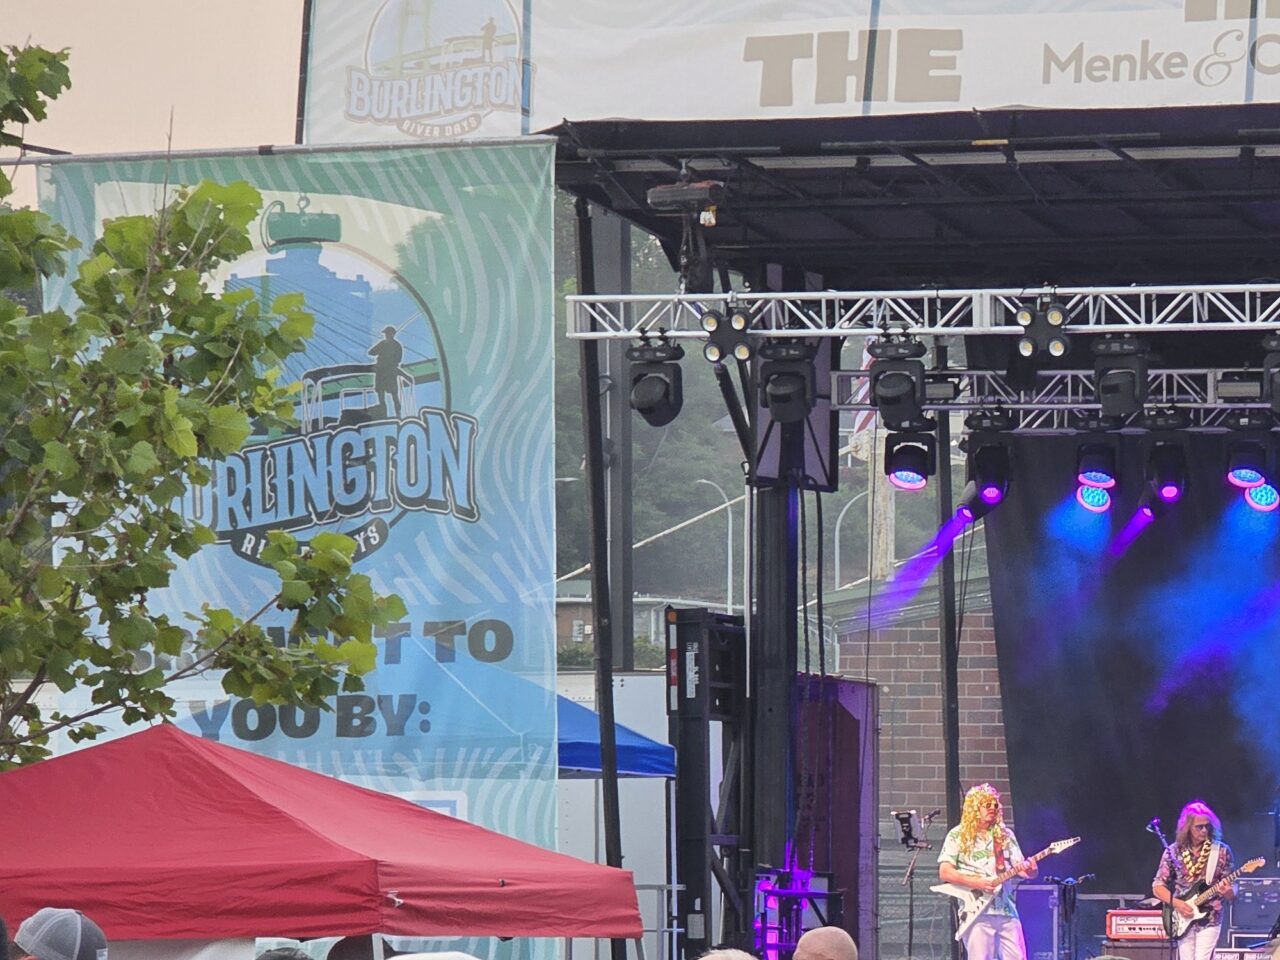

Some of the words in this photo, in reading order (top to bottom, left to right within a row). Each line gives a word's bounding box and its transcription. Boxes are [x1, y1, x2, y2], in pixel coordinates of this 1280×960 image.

[743, 28, 963, 107] THE
[1043, 40, 1188, 85] Menke
[346, 59, 534, 119] BURLINGTON
[402, 119, 440, 137] RIVER
[445, 117, 477, 136] DAYS
[176, 411, 476, 533] URLINGTON
[423, 619, 514, 664] TO
[189, 699, 320, 741] YOU
[336, 694, 432, 737] BY:
